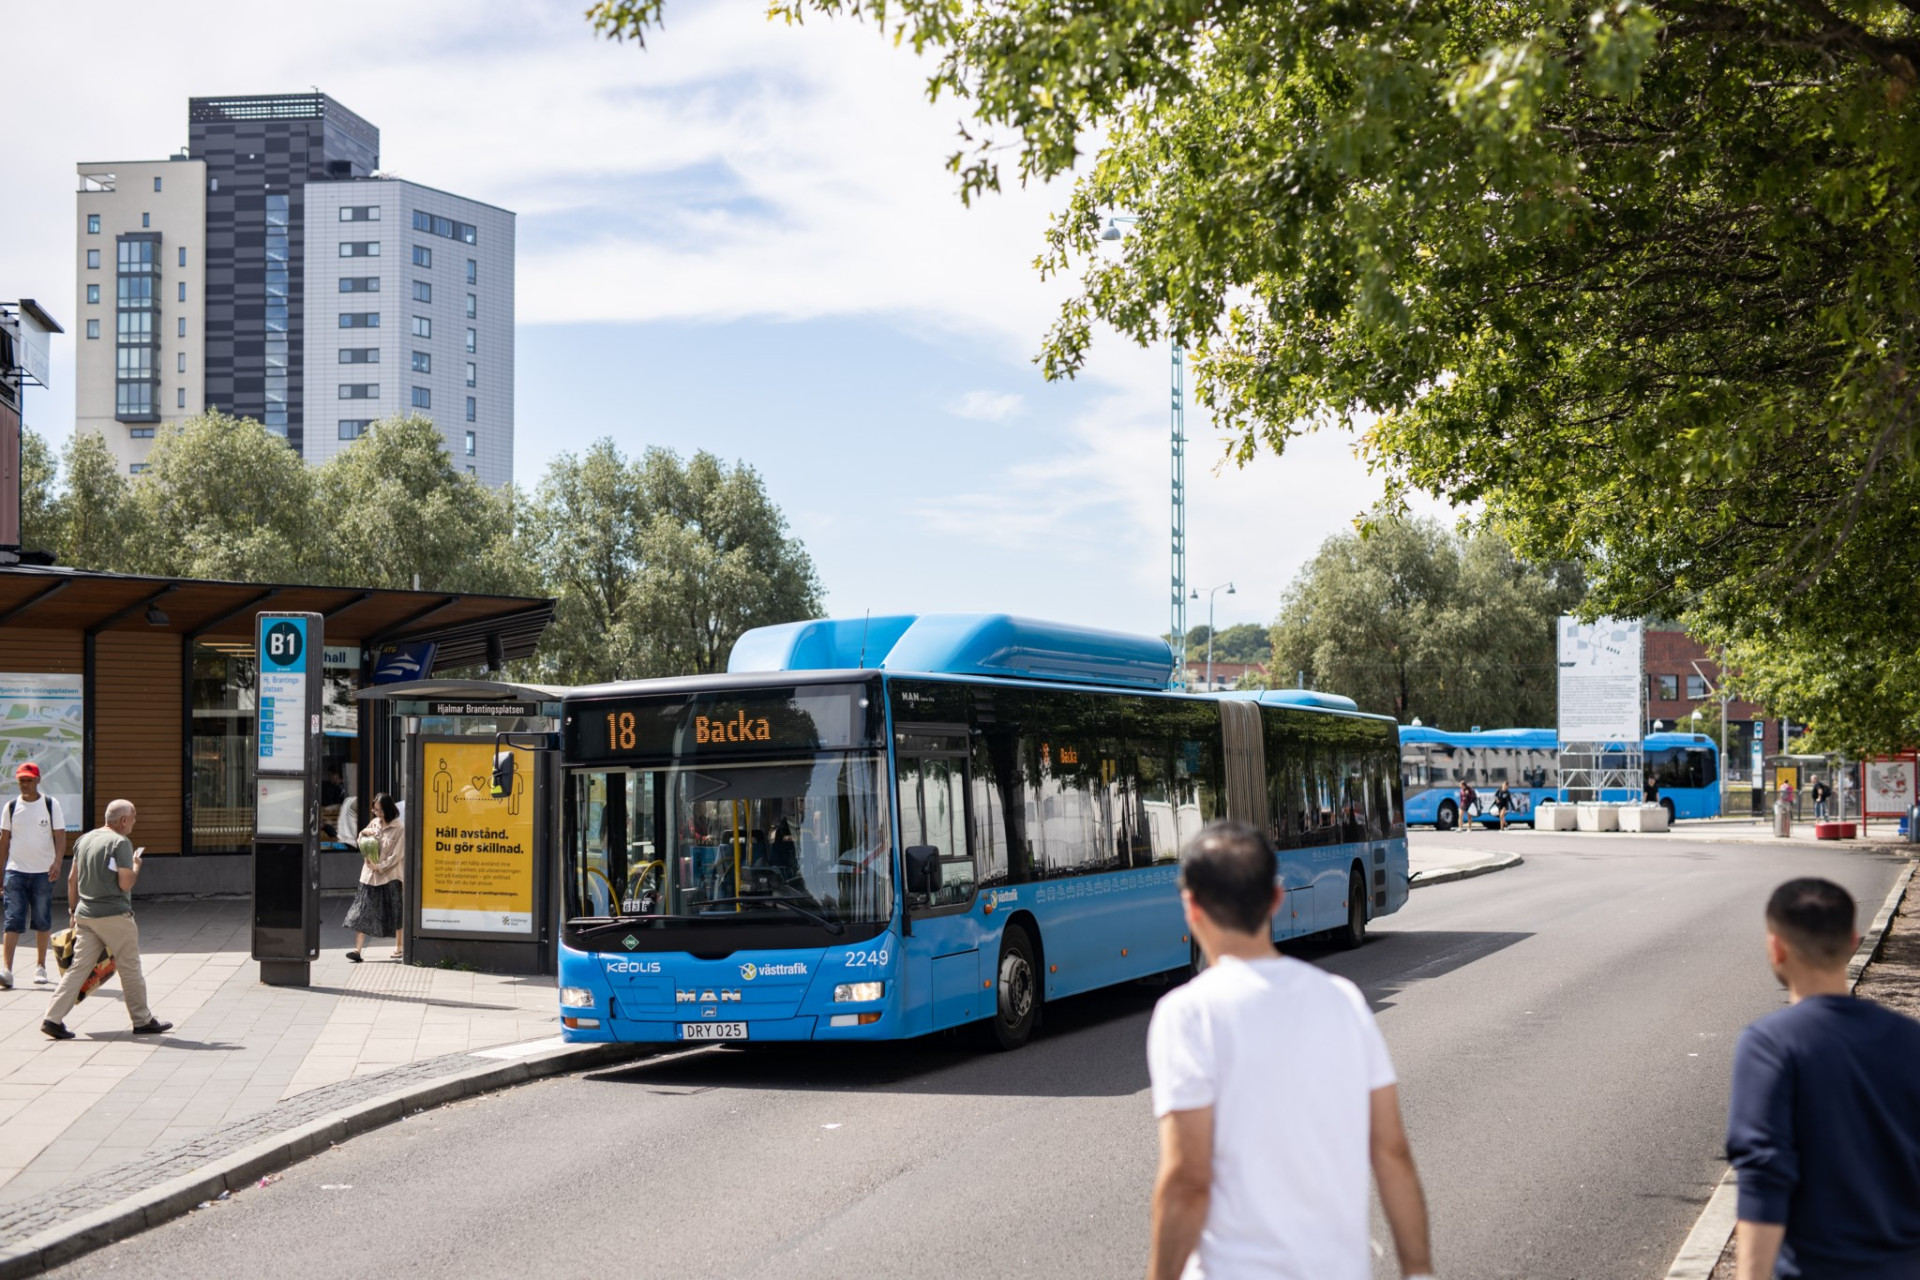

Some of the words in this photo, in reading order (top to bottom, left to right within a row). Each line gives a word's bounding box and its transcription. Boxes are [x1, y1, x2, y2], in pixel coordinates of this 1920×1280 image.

[270, 633, 295, 655] B1
[24, 687, 79, 695] Brantingsplatsen
[901, 691, 920, 701] MAN
[437, 704, 464, 715] Hjalmar
[466, 704, 525, 716] Brantingsplatsen
[265, 723, 274, 732] 45
[607, 712, 636, 750] 18
[695, 710, 771, 743] Backa
[262, 747, 272, 756] 142
[436, 826, 458, 838] Håll
[460, 827, 509, 839] avstånd.
[436, 842, 451, 851] Du
[454, 842, 474, 854] gör
[476, 842, 524, 854] skillnad.
[845, 950, 889, 968] 2249
[758, 962, 808, 976] västtrafik
[676, 988, 742, 1003] MAN
[687, 1024, 712, 1037] DRY
[716, 1023, 742, 1037] 025
